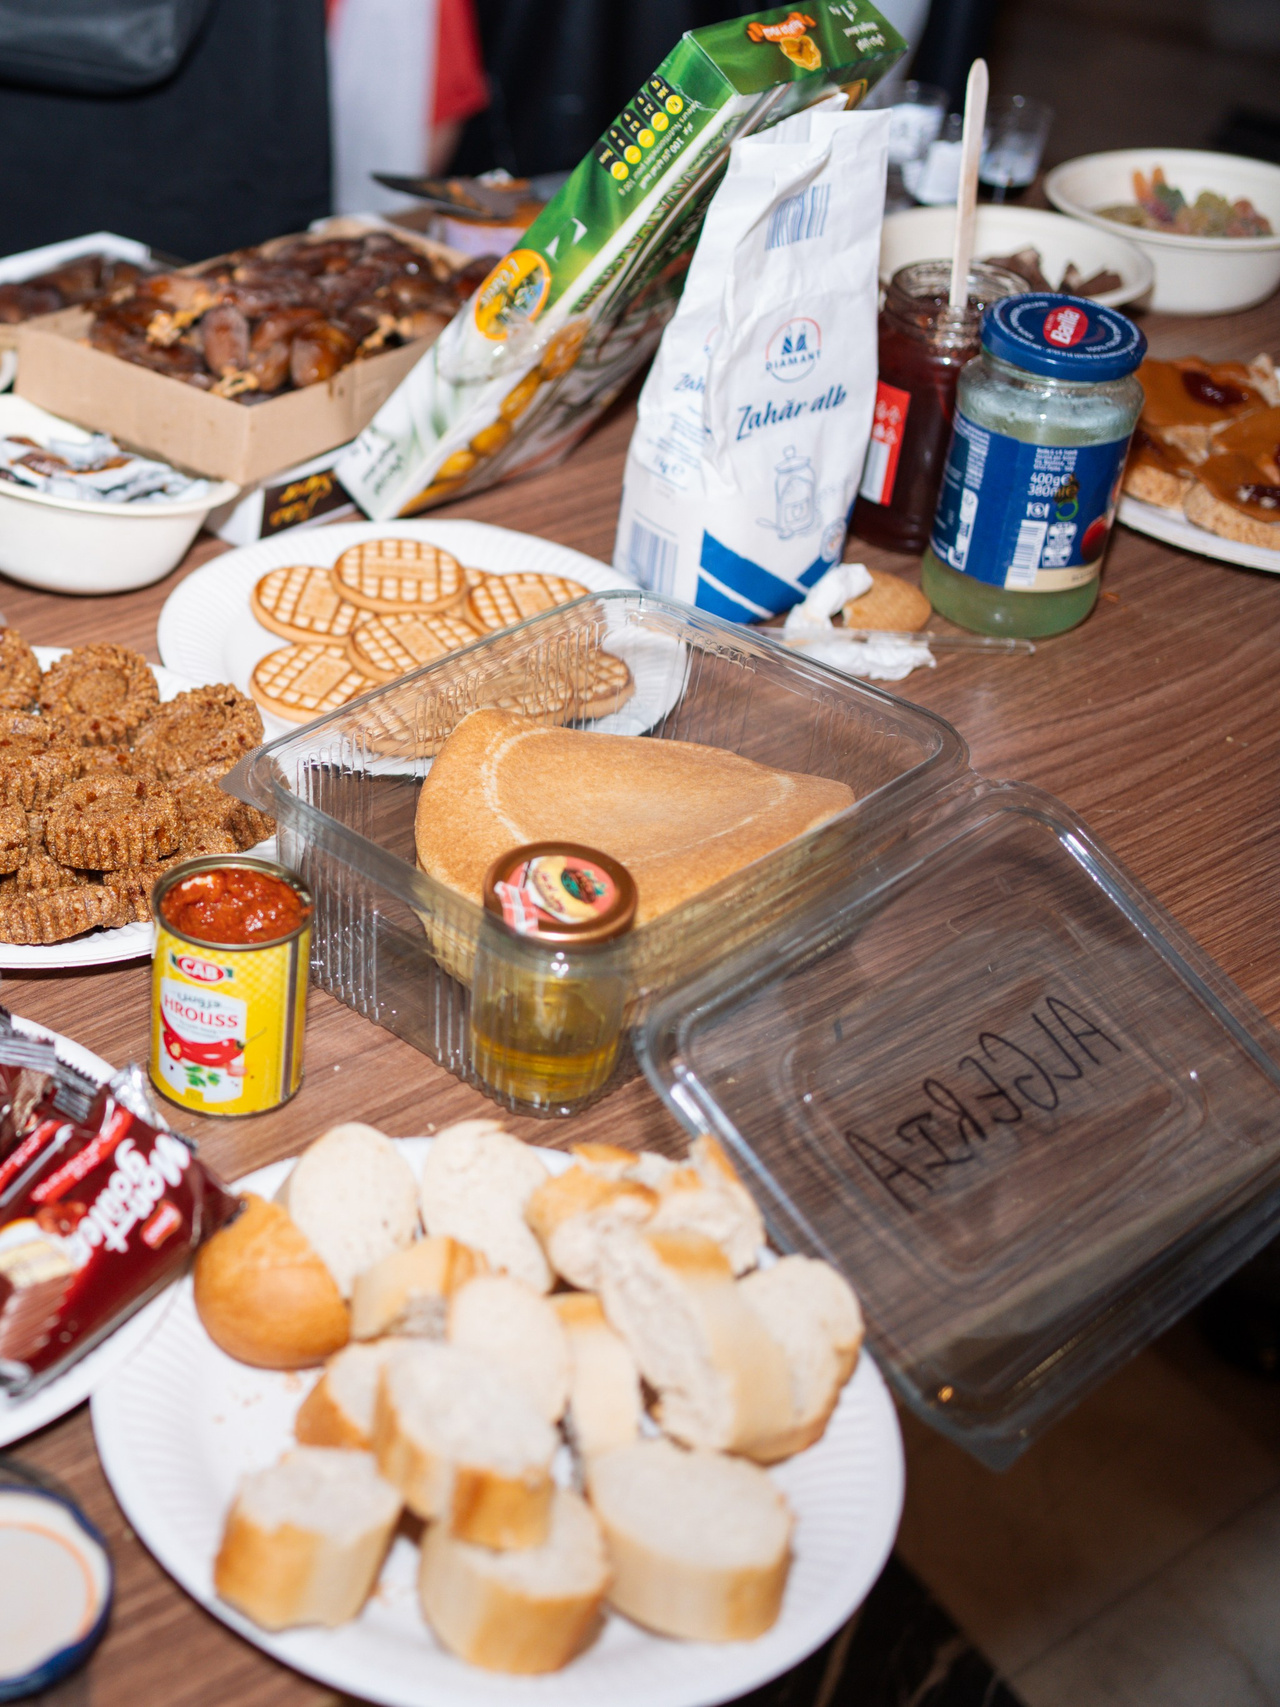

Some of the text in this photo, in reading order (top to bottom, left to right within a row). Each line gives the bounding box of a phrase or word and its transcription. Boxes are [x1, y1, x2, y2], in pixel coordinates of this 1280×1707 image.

[678, 100, 701, 123] Valeurs
[765, 350, 822, 371] DIAMANT
[736, 399, 808, 441] Zahăr
[810, 384, 847, 412] alb
[179, 959, 219, 982] CAB
[164, 994, 239, 1028] HROUSS
[125, 1135, 188, 1218] Mon
